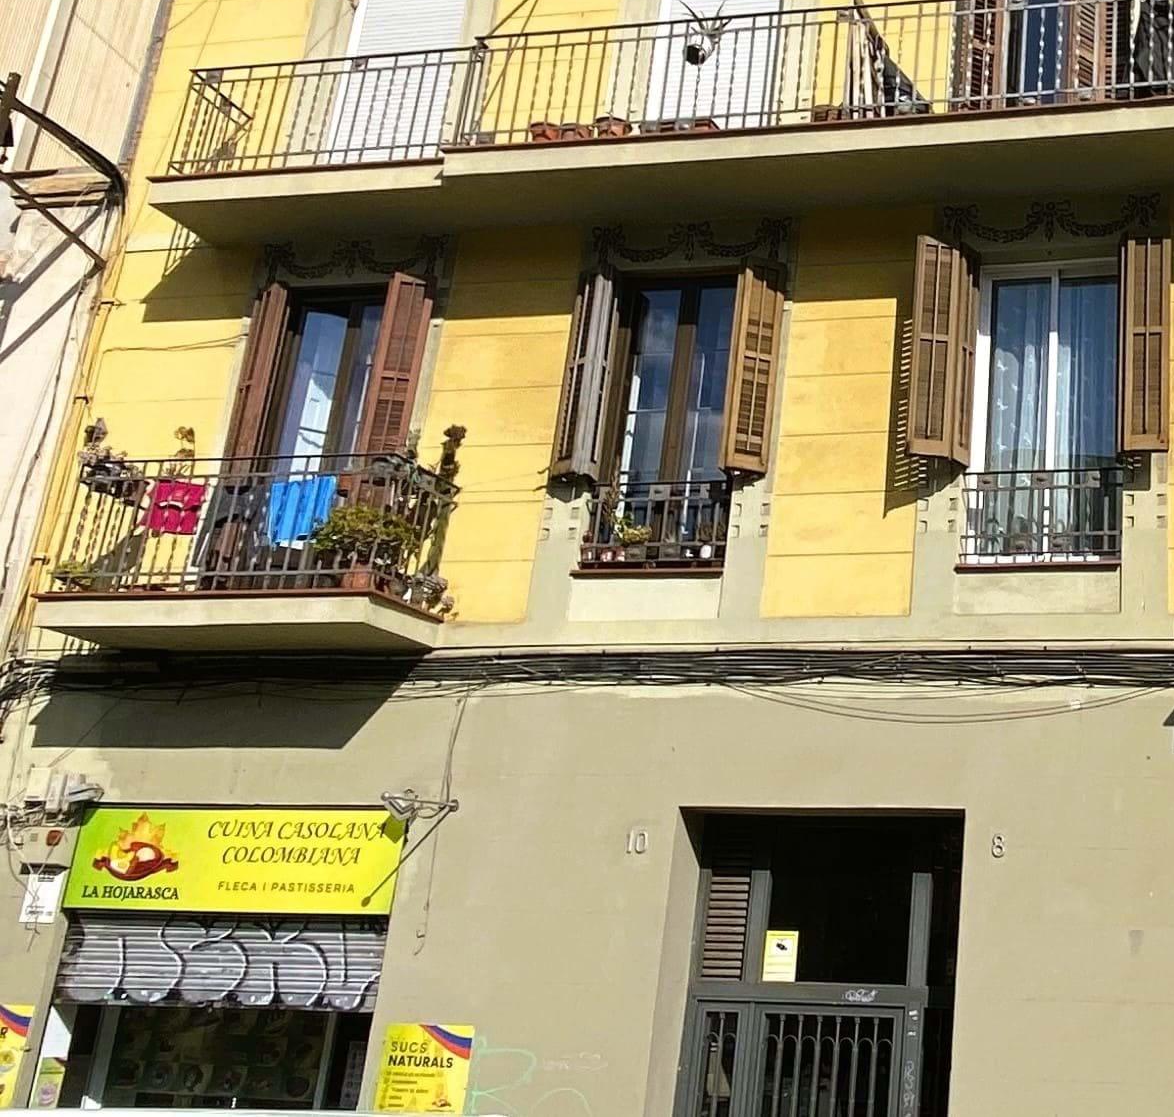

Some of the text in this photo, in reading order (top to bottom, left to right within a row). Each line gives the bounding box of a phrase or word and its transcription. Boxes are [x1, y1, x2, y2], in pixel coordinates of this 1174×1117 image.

[208, 820, 386, 841] CUINA CASOLANA
[626, 829, 649, 855] 10
[991, 832, 1005, 859] 8
[222, 846, 361, 867] COLOMBIANA
[82, 885, 179, 901] LA HOJARASCA
[218, 881, 257, 892] FLECA
[271, 882, 355, 894] PASTISSERIA
[391, 1041, 427, 1053] SUCS
[388, 1055, 453, 1068] NATURALS
